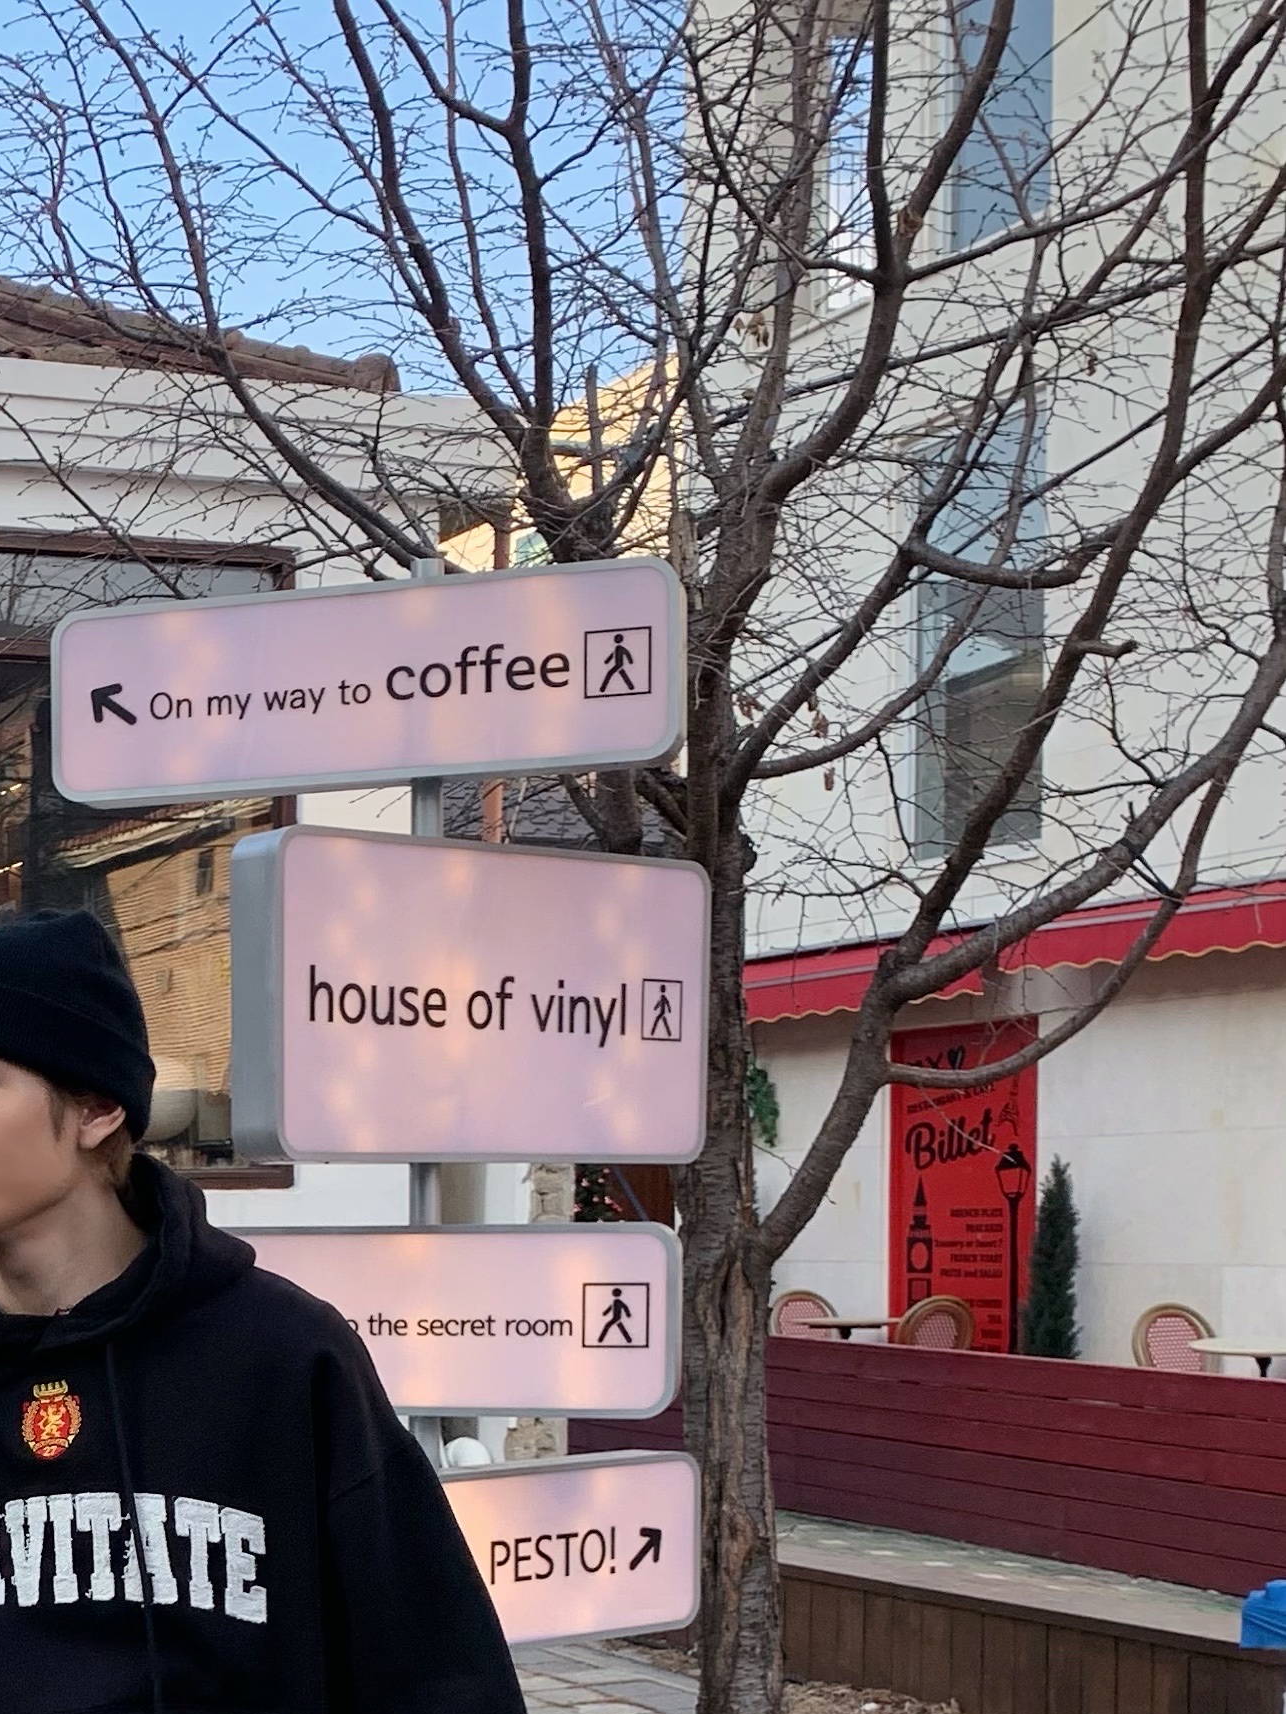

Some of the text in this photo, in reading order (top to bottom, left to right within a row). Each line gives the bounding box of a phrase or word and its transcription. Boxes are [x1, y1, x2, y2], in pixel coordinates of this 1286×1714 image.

[149, 643, 571, 721] On my way to coffee
[309, 964, 628, 1049] house of vinyl
[905, 1108, 995, 1170] Billet
[367, 1312, 408, 1337] the
[416, 1315, 496, 1337] secret
[505, 1319, 573, 1337] room
[490, 1526, 616, 1585] PESTO!
